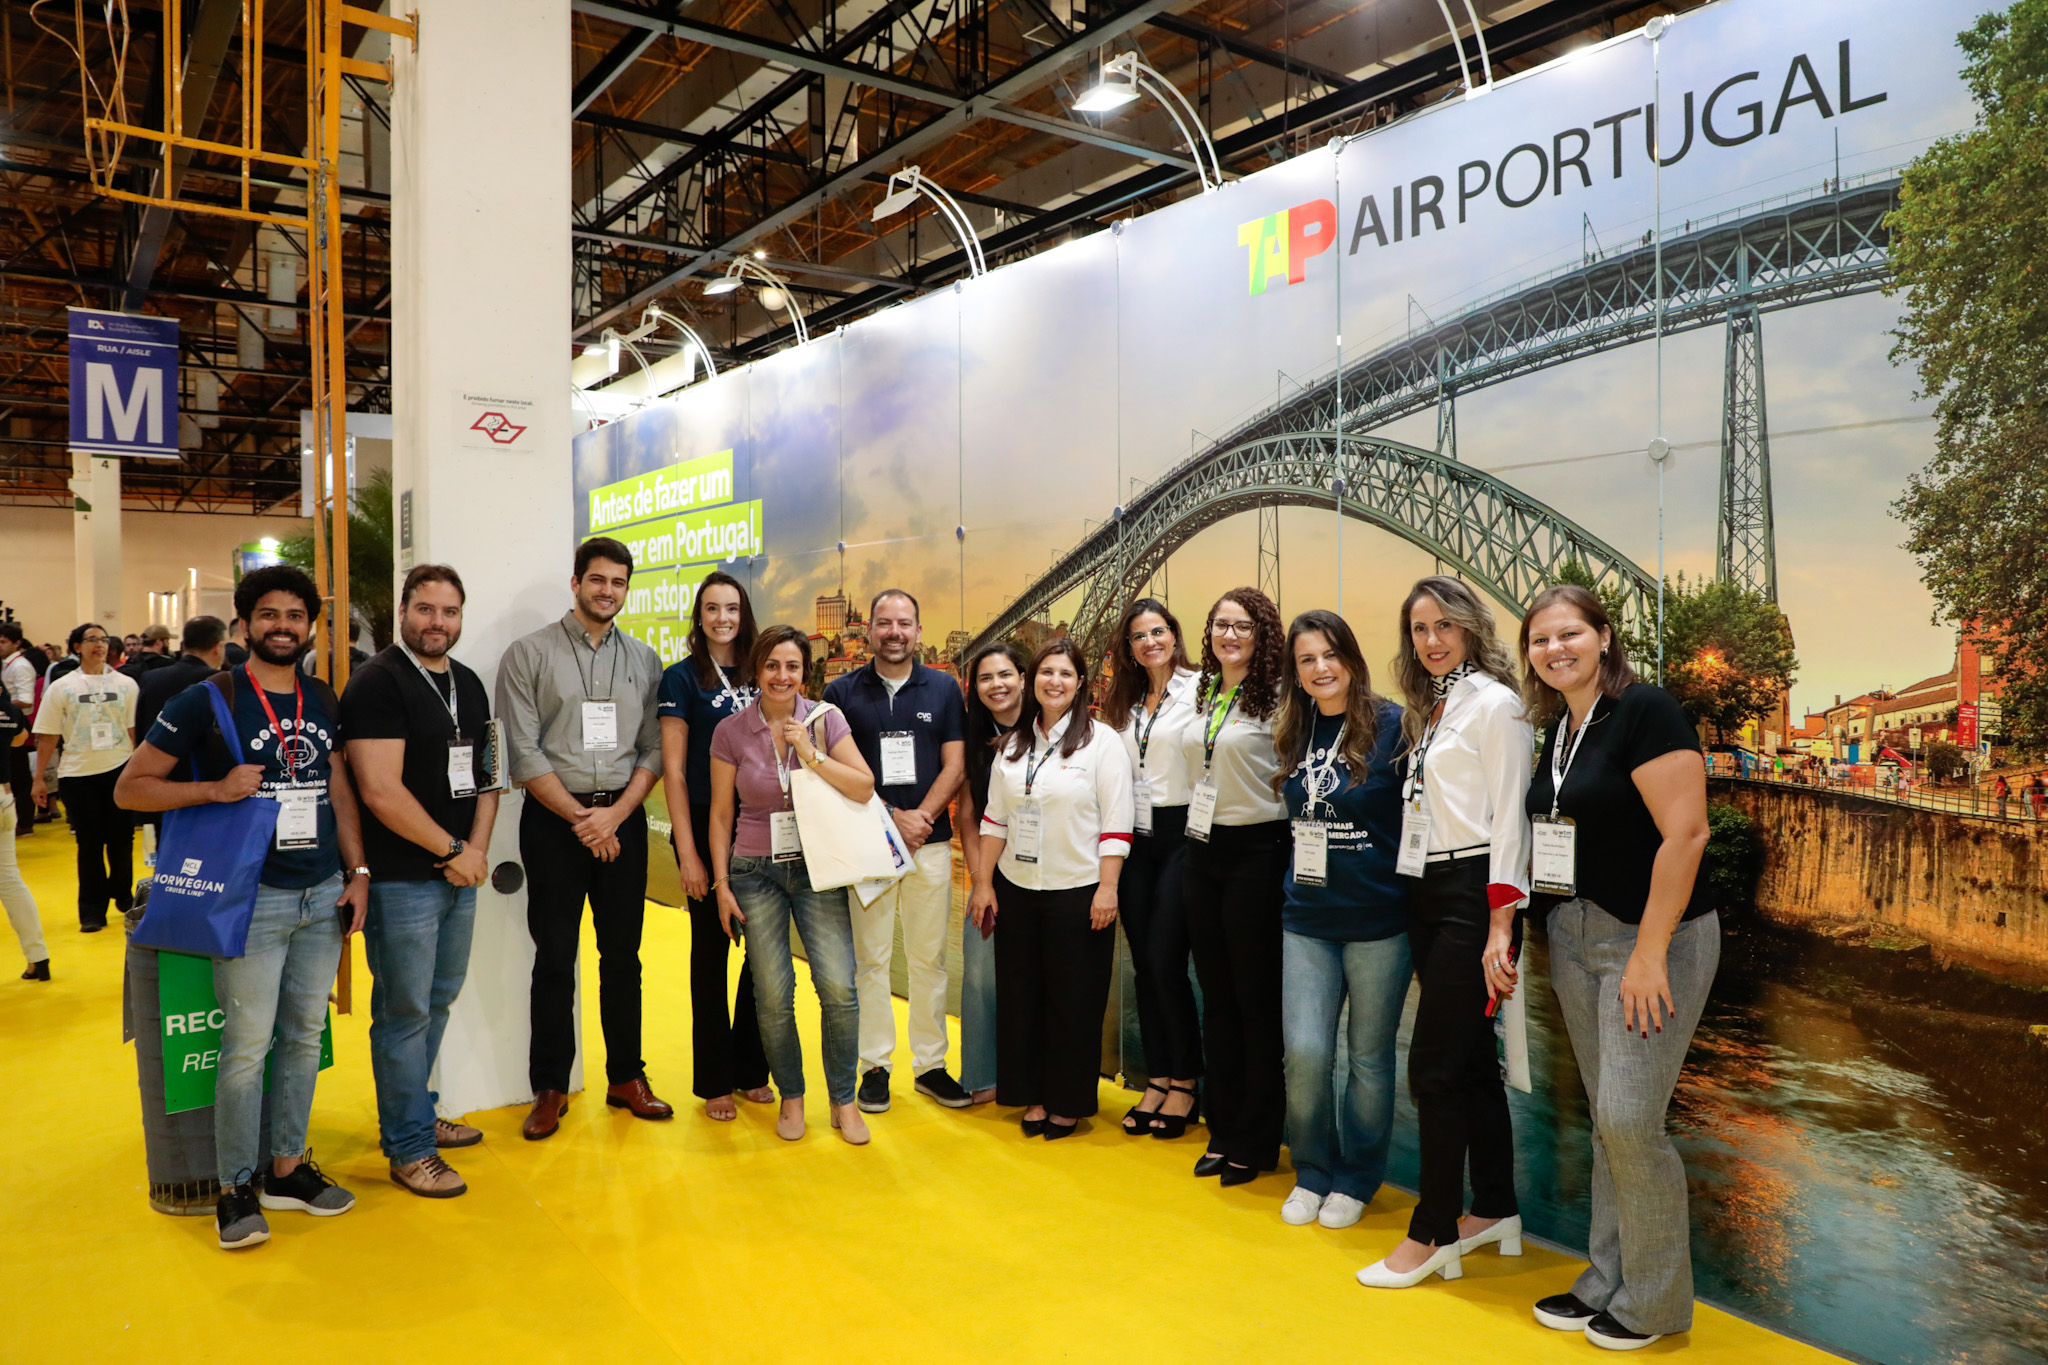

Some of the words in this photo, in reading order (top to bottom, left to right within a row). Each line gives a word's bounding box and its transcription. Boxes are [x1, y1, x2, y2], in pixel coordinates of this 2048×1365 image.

[1237, 198, 1337, 296] TAP
[97, 344, 118, 353] RUA
[119, 346, 126, 354] /
[126, 348, 151, 357] AISLE
[86, 361, 163, 444] M
[101, 460, 109, 469] 4
[591, 494, 632, 528] Antes
[634, 480, 653, 515] de
[654, 474, 698, 511] fazer
[700, 467, 730, 499] um
[647, 532, 674, 563] em
[676, 508, 760, 564] Portugal,
[627, 587, 651, 615] um
[654, 578, 690, 621] stop
[916, 711, 932, 719] CVC
[489, 722, 498, 786] COLOMBIA
[1333, 821, 1354, 830] MAIS
[1328, 830, 1368, 840] MERCADO
[184, 861, 198, 870] NCL
[154, 873, 225, 893] NORWEGIAN
[165, 886, 186, 895] CRUISE
